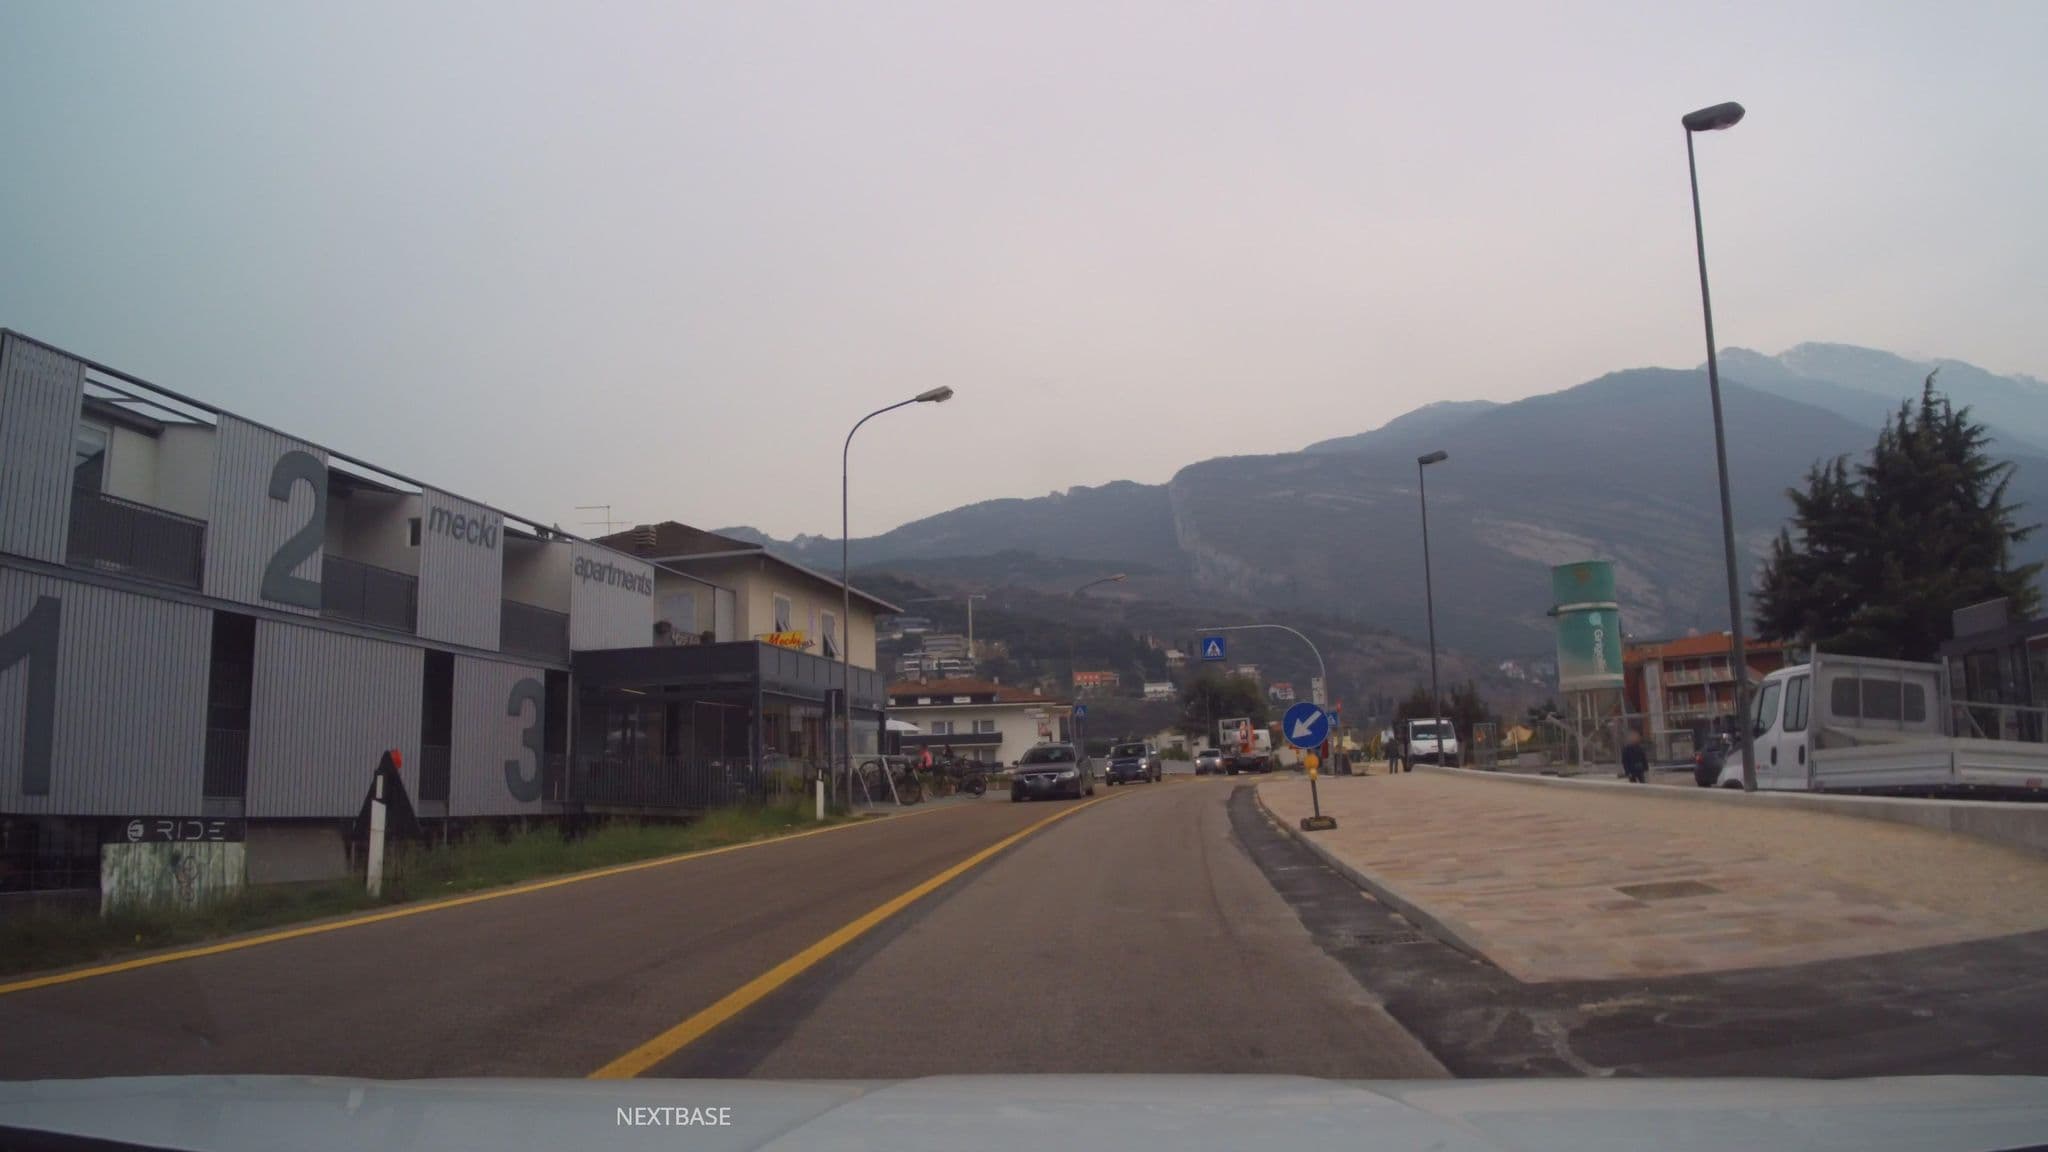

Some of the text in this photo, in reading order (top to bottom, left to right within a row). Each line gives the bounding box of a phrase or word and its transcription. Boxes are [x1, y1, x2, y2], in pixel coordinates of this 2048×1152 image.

[260, 450, 328, 610] 2
[428, 504, 501, 549] mecki
[573, 555, 653, 598] apartments
[504, 677, 546, 803] 3
[156, 820, 226, 841] RIDE
